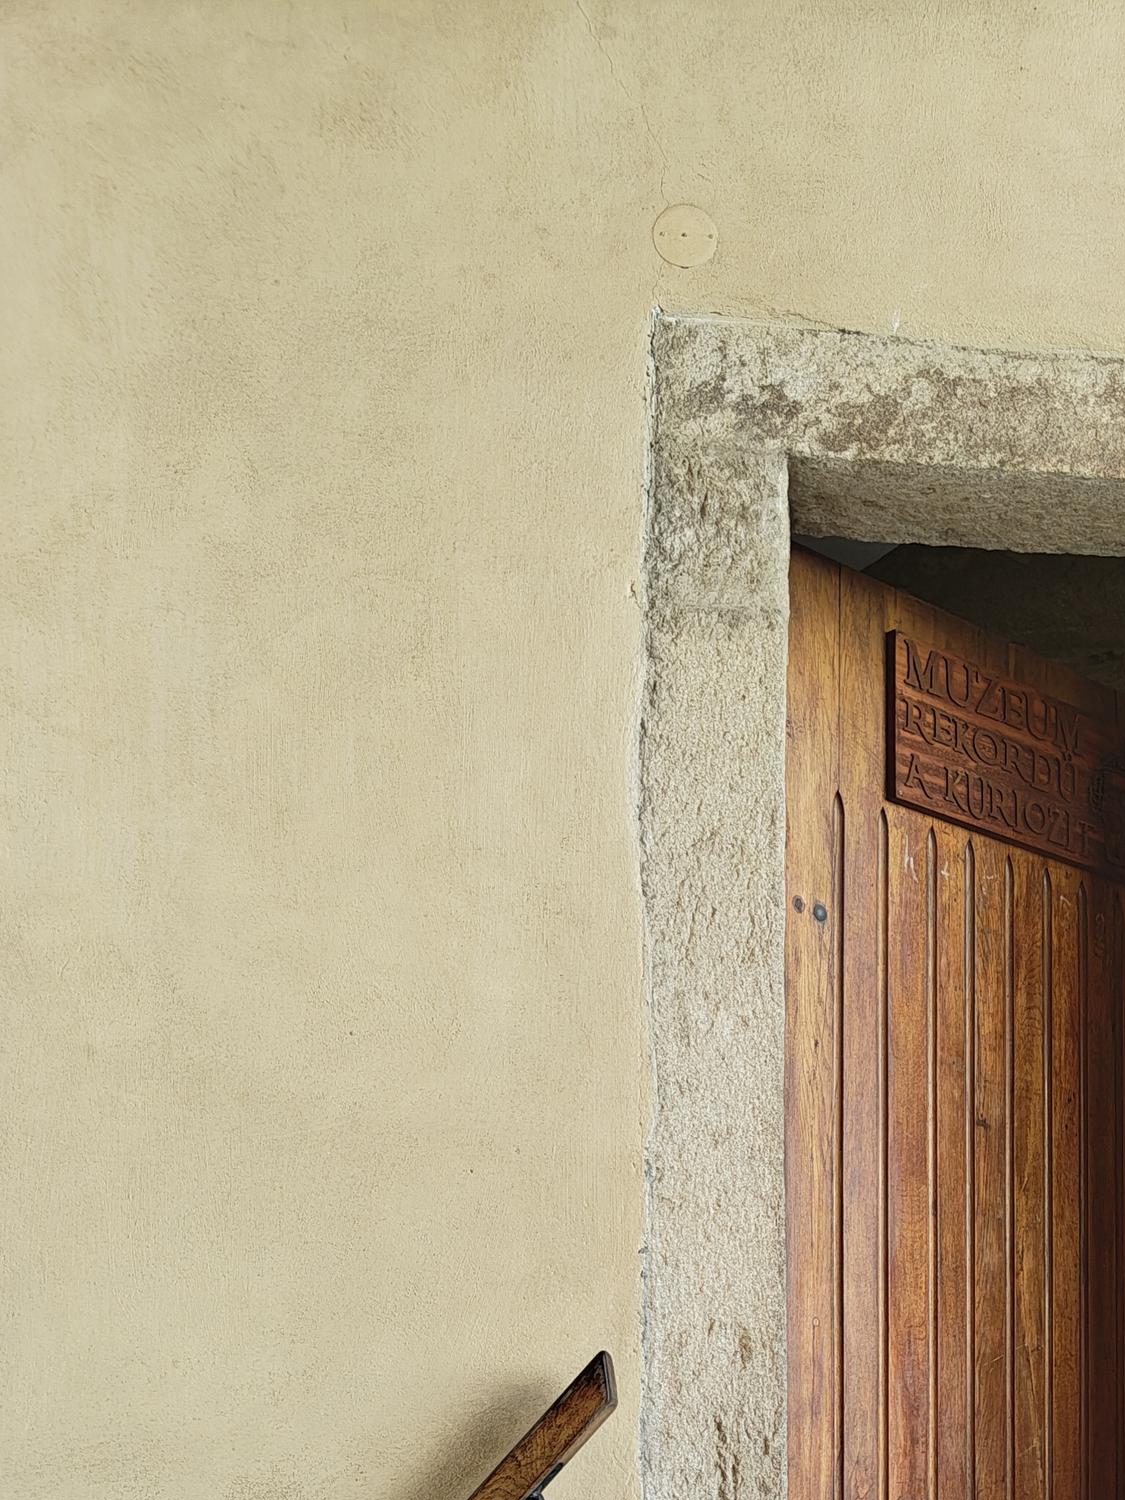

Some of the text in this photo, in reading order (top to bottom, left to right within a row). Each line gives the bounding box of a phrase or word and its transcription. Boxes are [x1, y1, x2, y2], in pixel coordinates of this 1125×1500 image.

[902, 638, 1082, 755] MUZEUM
[901, 697, 1078, 805] REKORDŮ
[902, 752, 934, 801] A
